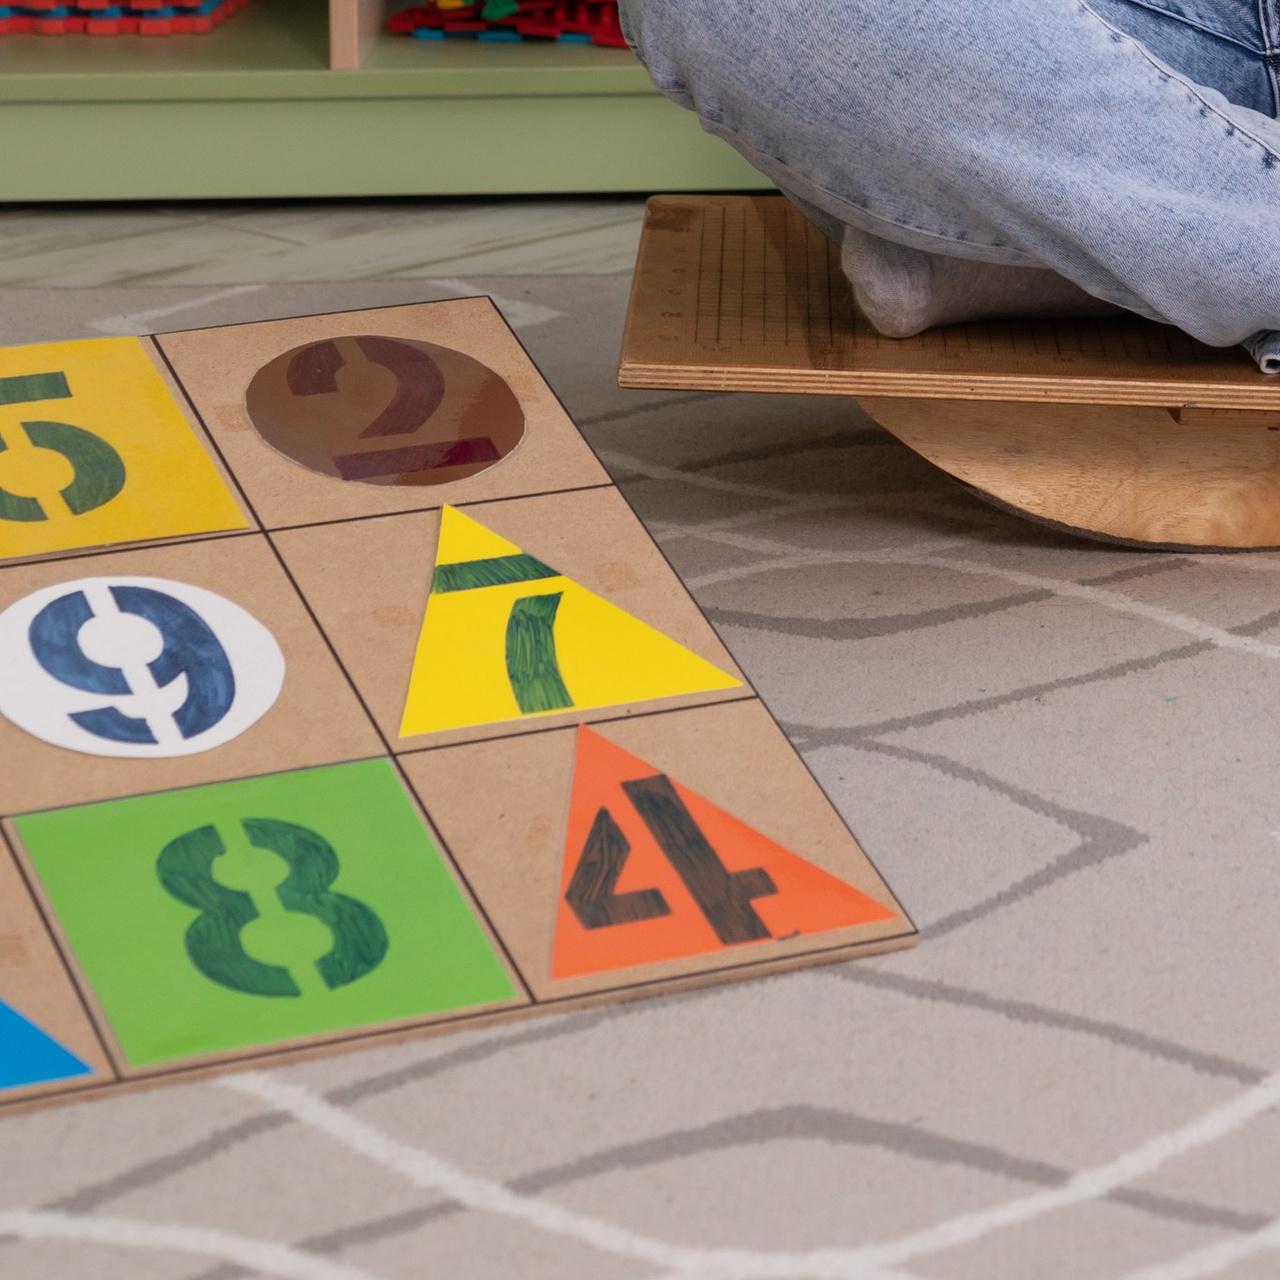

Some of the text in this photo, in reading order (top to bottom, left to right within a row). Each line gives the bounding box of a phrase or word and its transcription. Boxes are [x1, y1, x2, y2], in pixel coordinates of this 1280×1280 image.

[286, 338, 501, 482] 2
[28, 586, 236, 745] 9
[430, 551, 576, 715] 7
[156, 817, 390, 999] 8
[565, 773, 779, 946] 4
